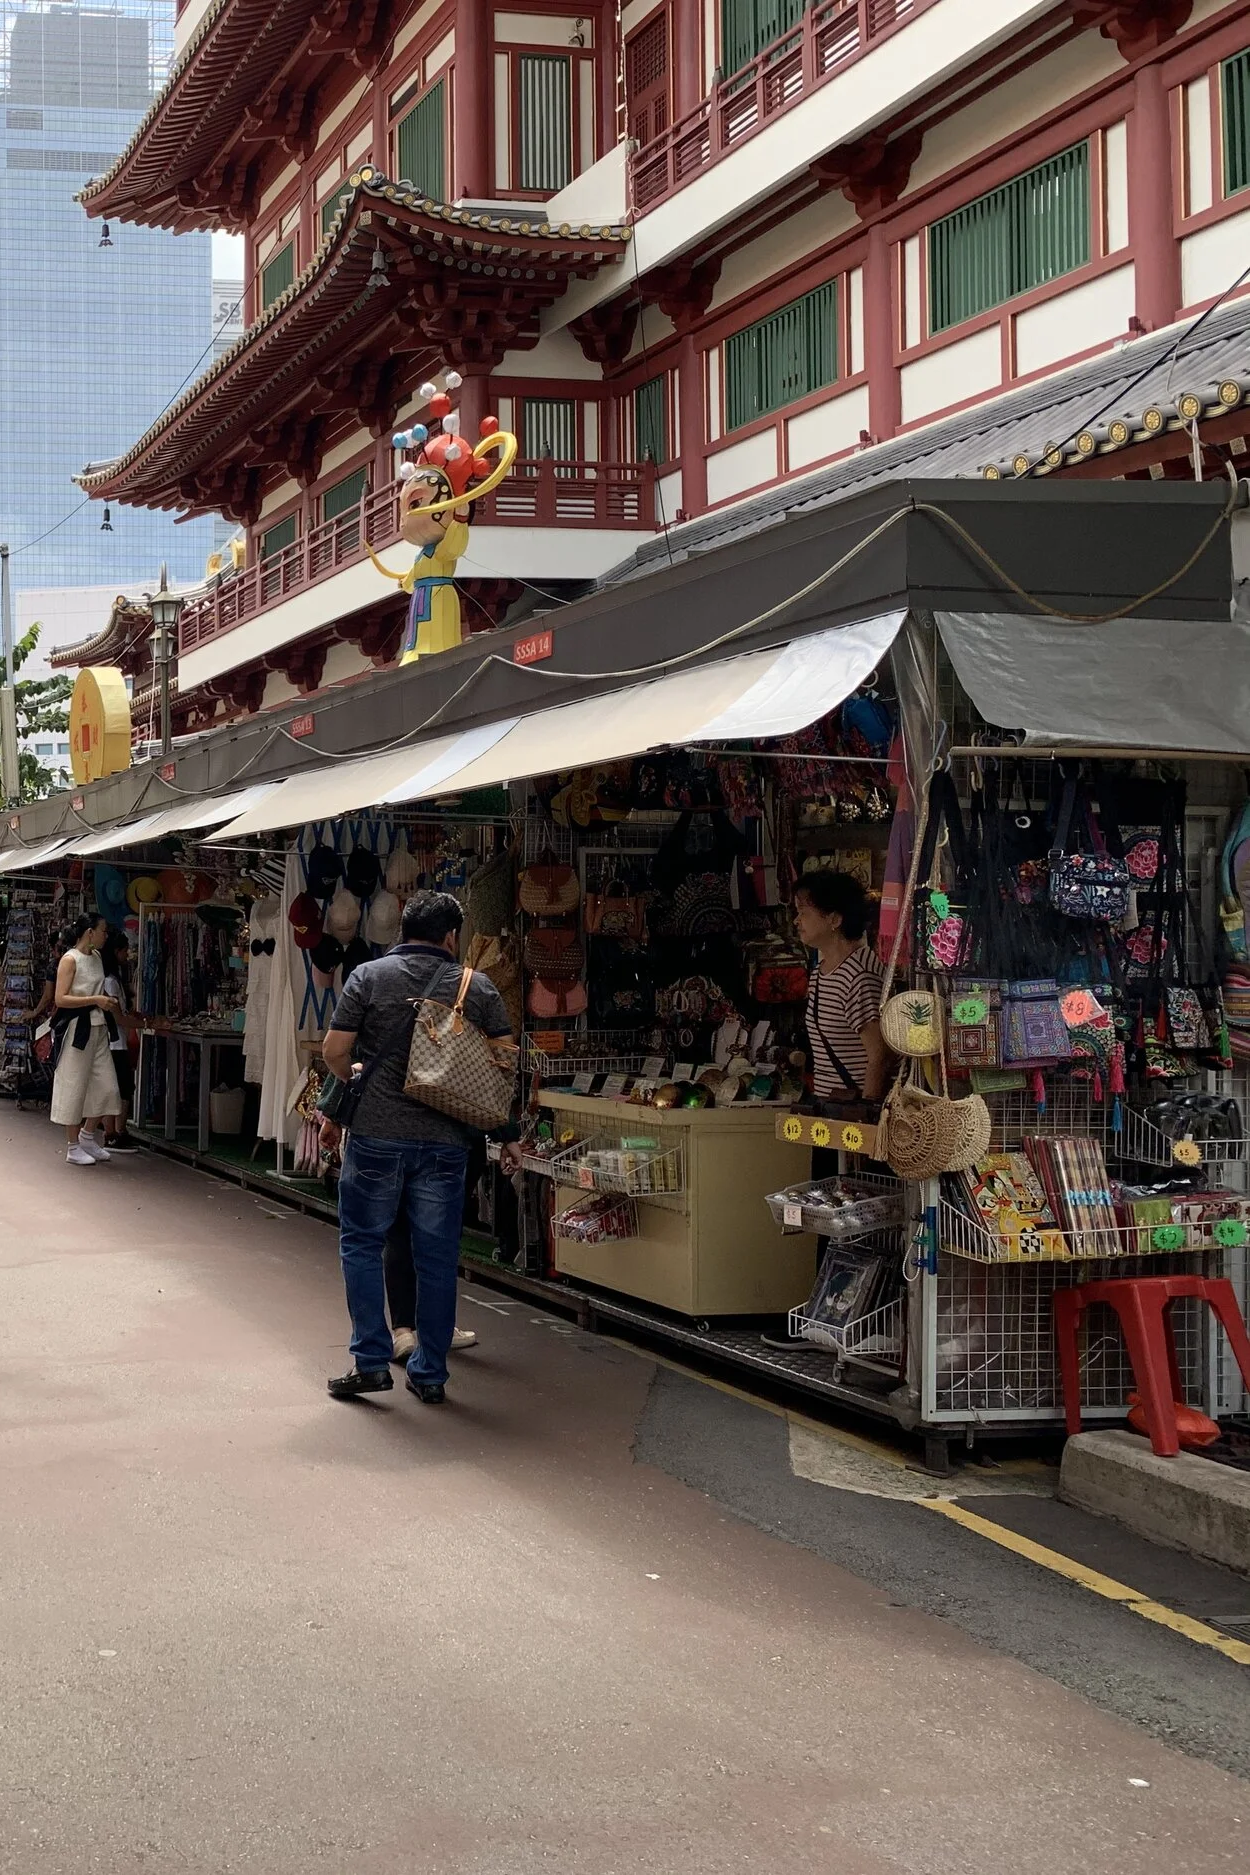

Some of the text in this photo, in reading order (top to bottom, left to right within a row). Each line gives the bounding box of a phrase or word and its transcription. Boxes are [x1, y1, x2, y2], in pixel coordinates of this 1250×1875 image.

[516, 636, 549, 660] SSSA 14
[960, 1006, 976, 1017] $5
[787, 1125, 799, 1134] $12
[846, 1132, 858, 1143] $10
